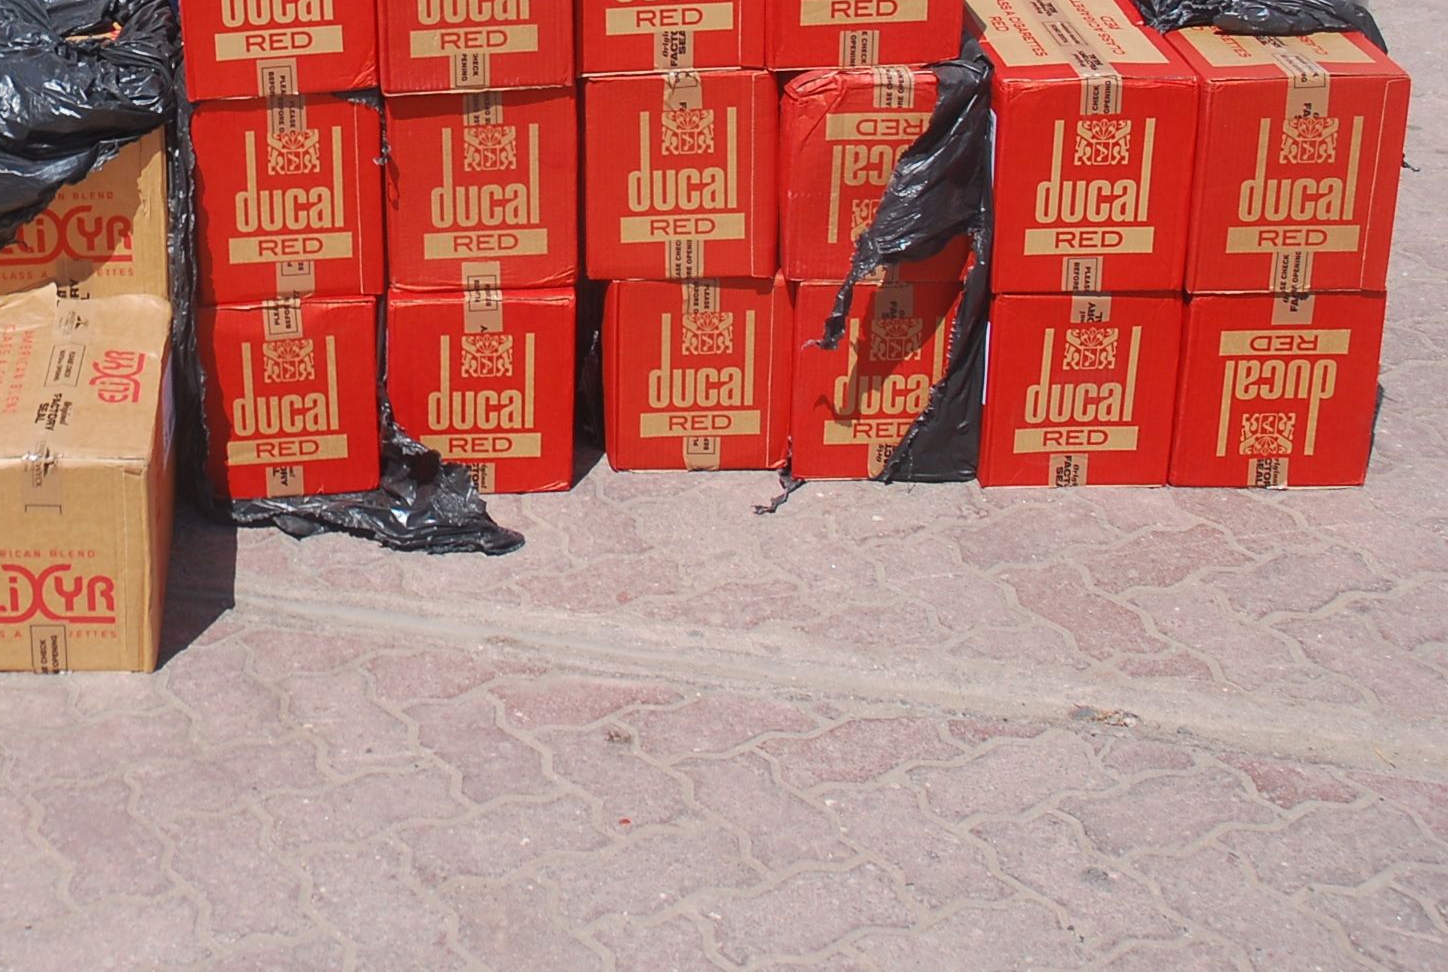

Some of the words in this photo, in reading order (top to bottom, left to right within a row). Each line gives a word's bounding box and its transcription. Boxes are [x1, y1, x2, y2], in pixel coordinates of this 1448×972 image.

[636, 7, 704, 28] RED
[988, 16, 1009, 32] RED
[1100, 16, 1123, 30] RED
[244, 30, 313, 53] RED
[440, 30, 508, 50] RED
[1009, 16, 1048, 57] CIGARETTES
[1099, 33, 1125, 55] CLASS
[856, 118, 925, 136] RED
[627, 106, 738, 212] ducal
[1238, 116, 1365, 221] ducal
[235, 125, 344, 233] ducal
[430, 123, 540, 228] ducal
[1035, 117, 1157, 223] ducal
[72, 191, 114, 199] BLEND
[649, 218, 717, 237] RED
[1257, 228, 1329, 247] RED
[258, 237, 324, 257] RED
[453, 233, 519, 253] RED
[1054, 230, 1124, 249] RED
[97, 268, 135, 276] ETTES
[1249, 335, 1319, 352] RED
[648, 310, 756, 408] ducal
[428, 332, 535, 430] ducal
[1024, 326, 1143, 424] ducal
[233, 335, 340, 437] ducal
[34, 403, 50, 424] SEAL
[45, 393, 63, 431] FACTORY
[1216, 358, 1338, 457] ducal
[668, 413, 732, 431] RED
[448, 436, 513, 454] RED
[1042, 429, 1109, 447] RED
[255, 439, 320, 459] RED
[49, 549, 96, 558] BLEND
